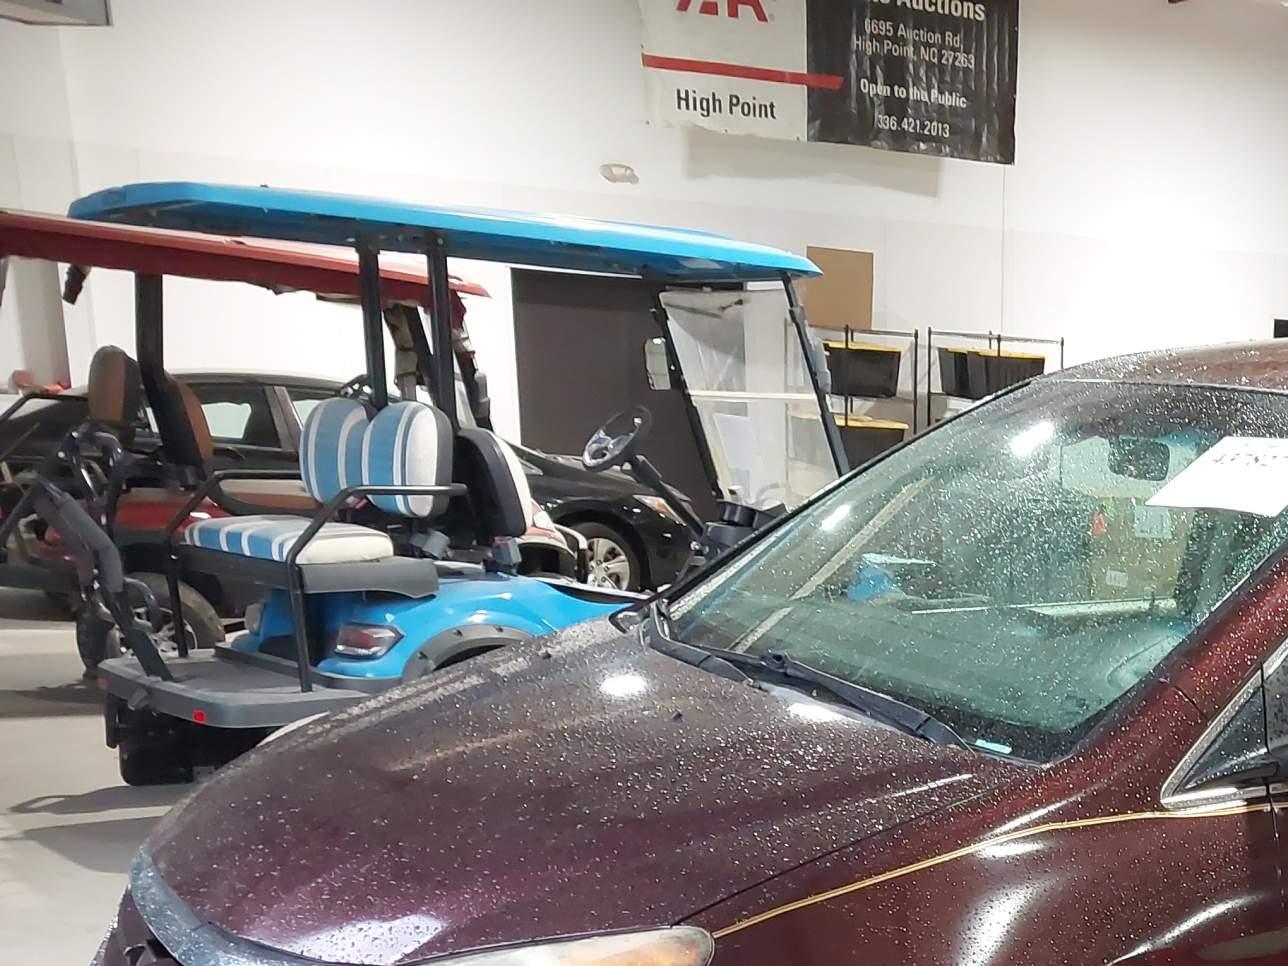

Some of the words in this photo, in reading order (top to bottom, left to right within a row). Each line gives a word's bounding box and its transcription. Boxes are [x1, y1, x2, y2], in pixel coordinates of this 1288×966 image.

[864, 18, 894, 37] 6695
[897, 24, 942, 44] Auction
[853, 36, 881, 55] High
[941, 50, 975, 69] 27263
[676, 88, 722, 118] High
[728, 94, 777, 119] Point
[860, 78, 891, 97] Open
[894, 85, 907, 98] to
[931, 90, 968, 108] Public
[877, 114, 951, 138] 336.421.2013
